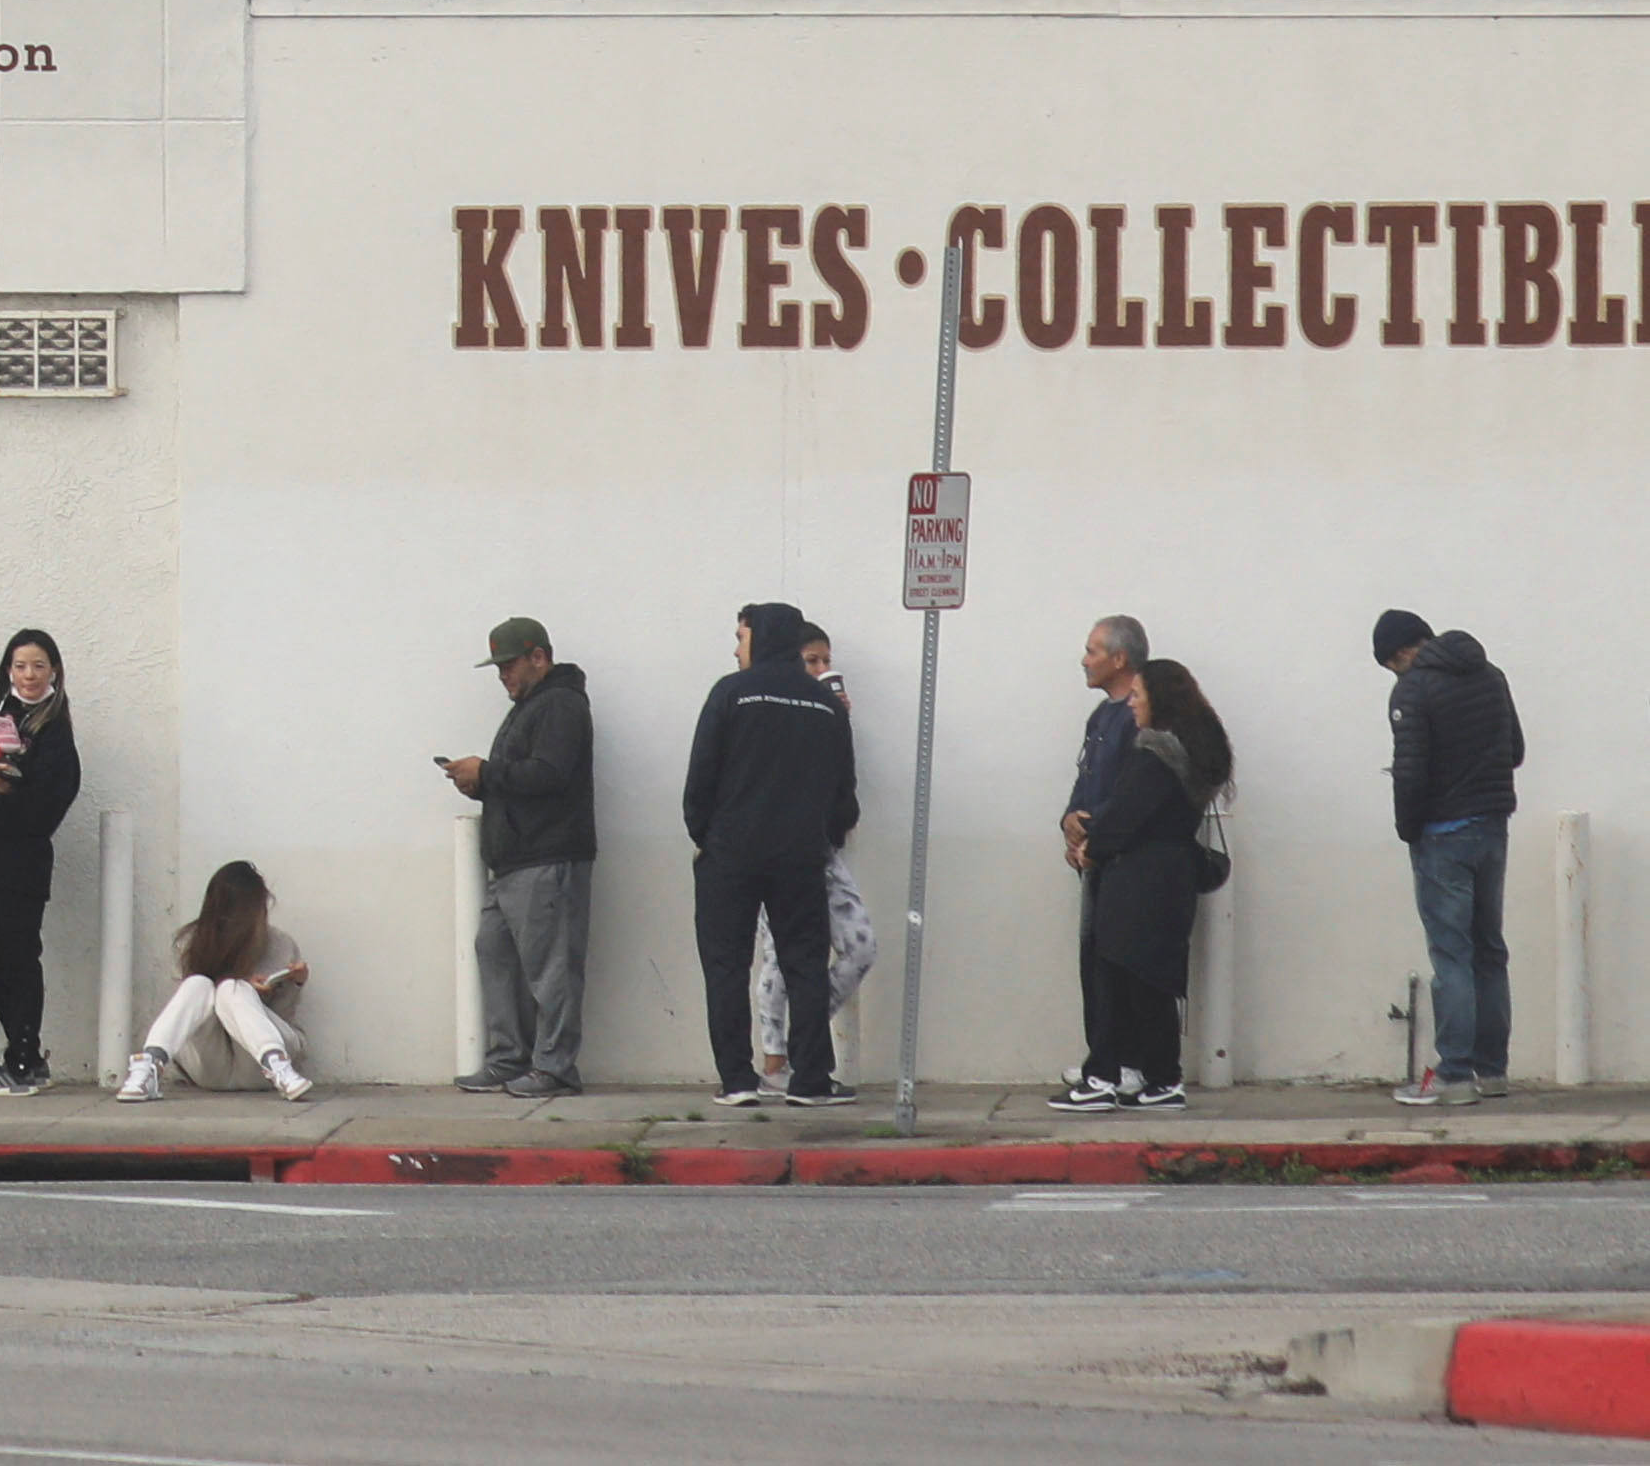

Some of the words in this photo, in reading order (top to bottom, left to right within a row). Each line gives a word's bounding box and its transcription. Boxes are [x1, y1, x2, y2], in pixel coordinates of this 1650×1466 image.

[451, 203, 871, 351] KNIVES
[944, 201, 1650, 350] COLLECTIBL
[913, 479, 934, 509] NO
[911, 519, 963, 543] PARKING
